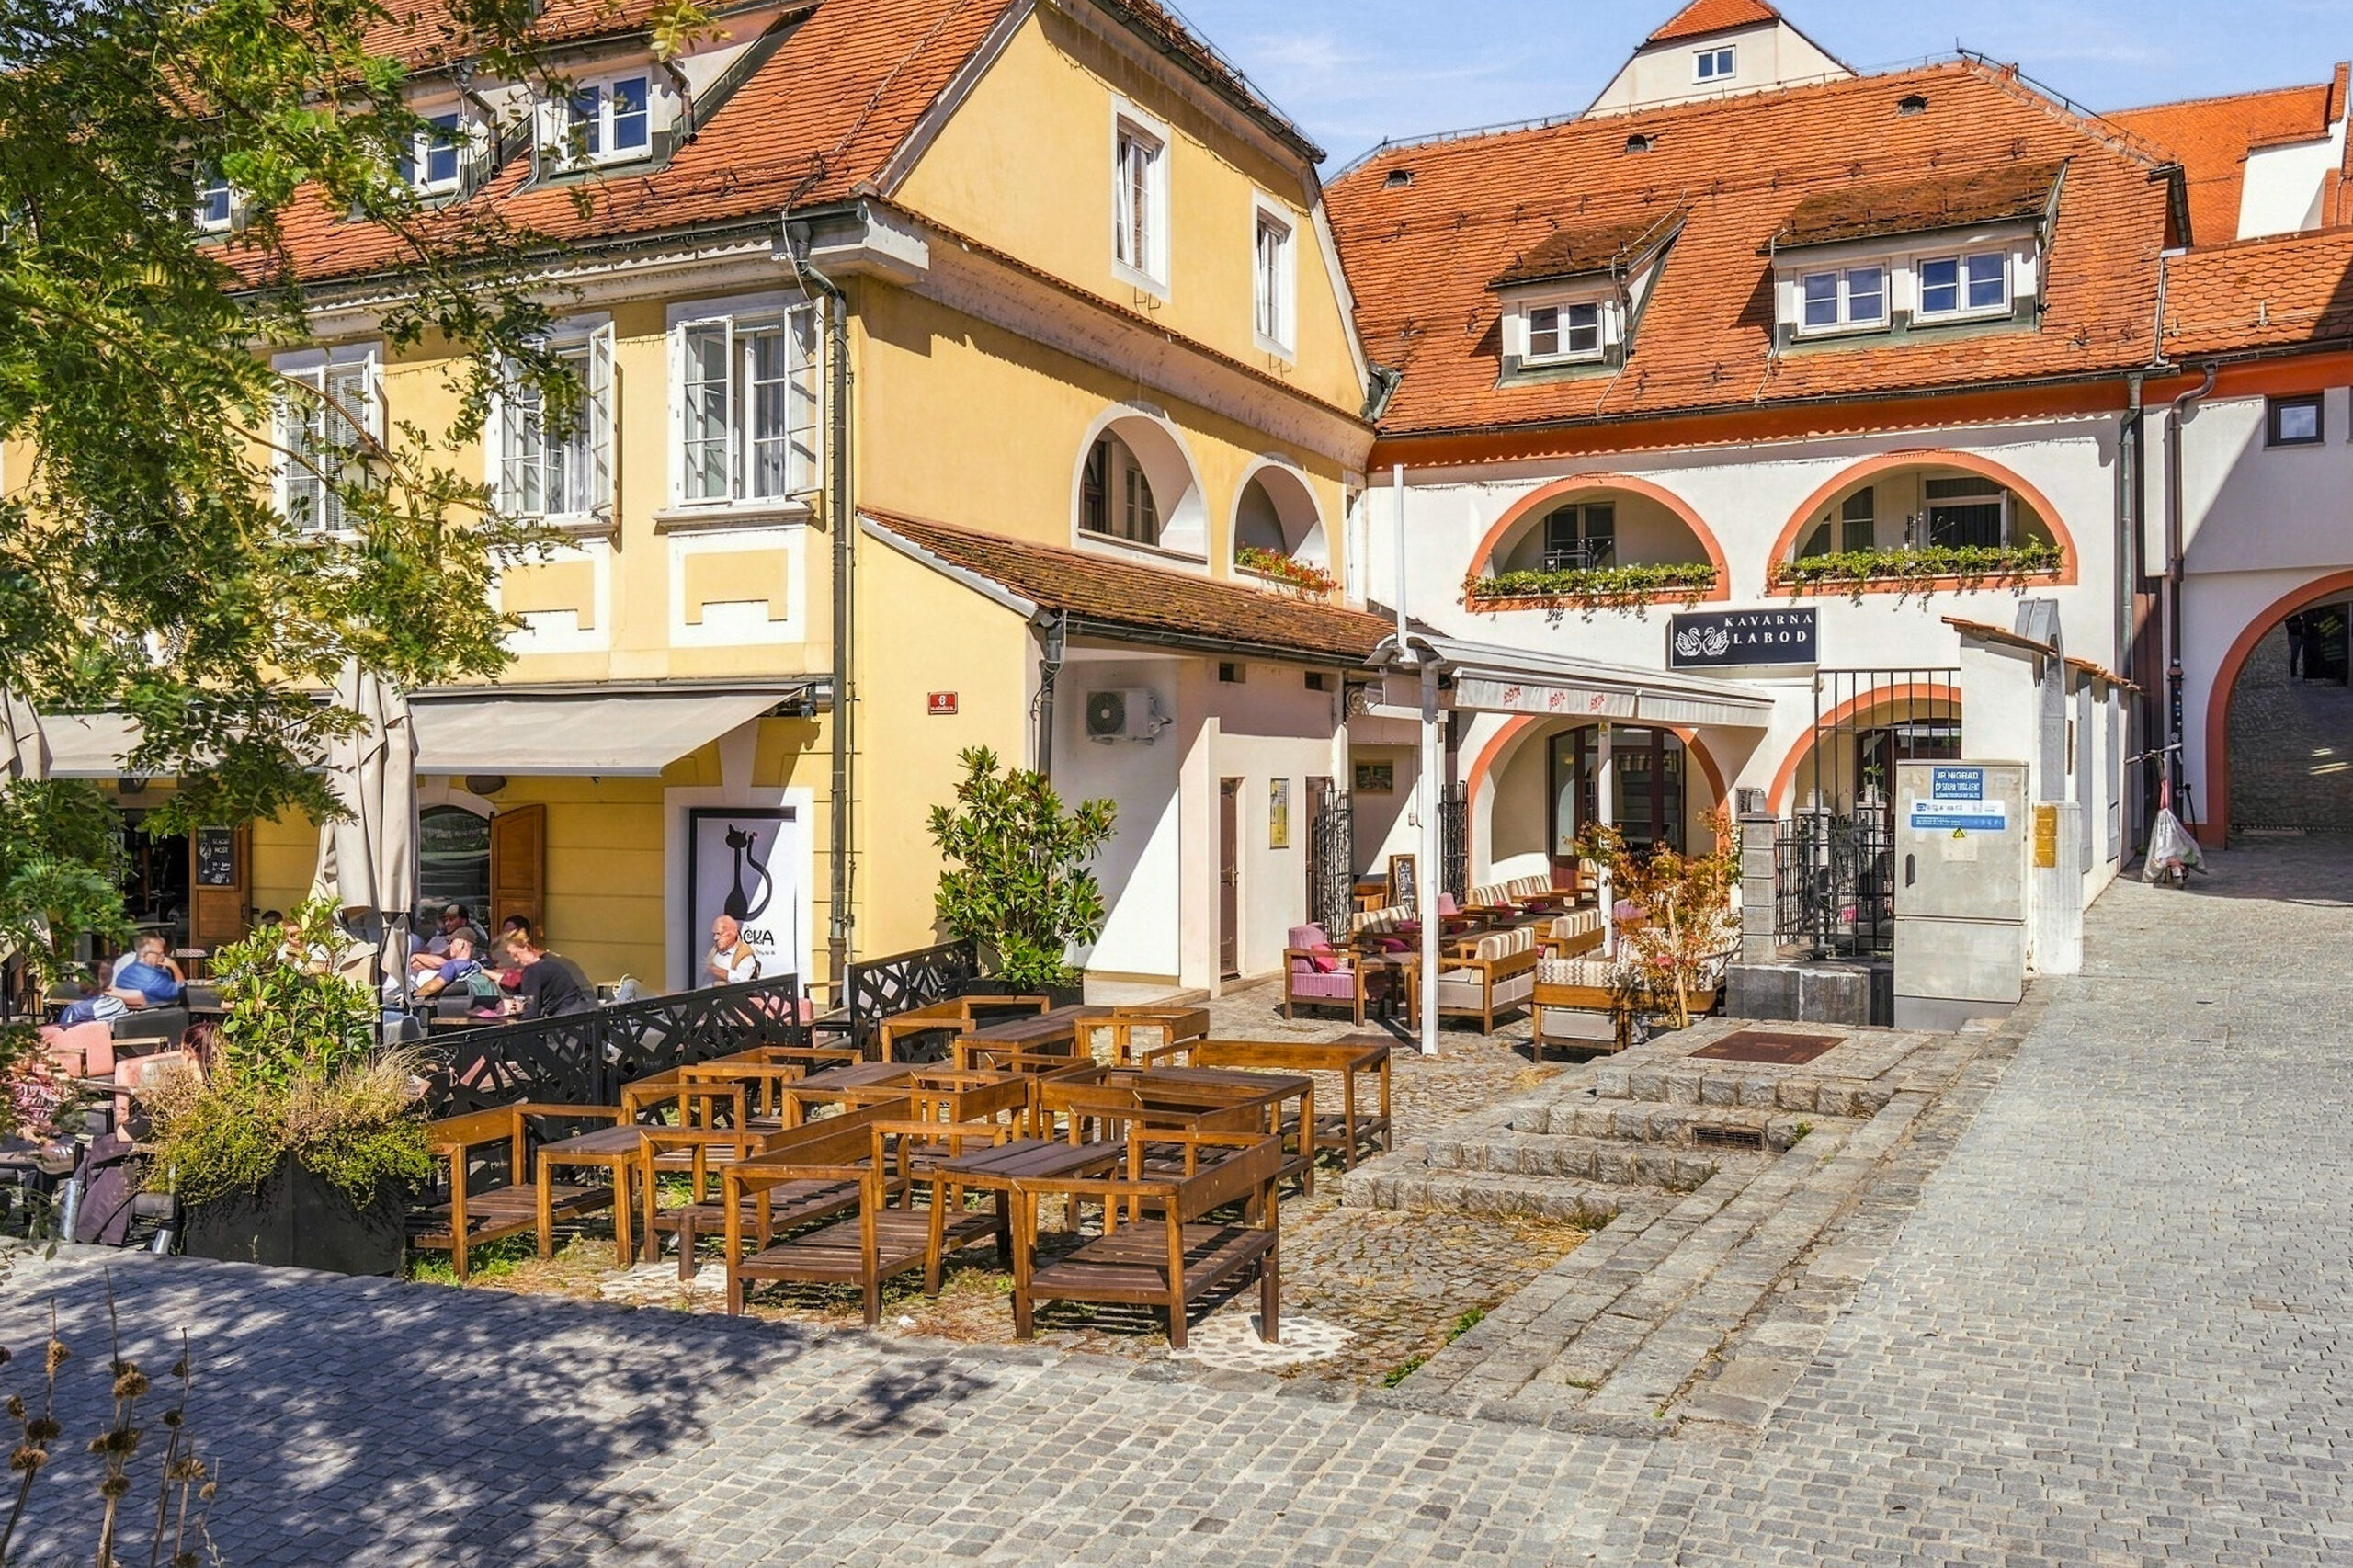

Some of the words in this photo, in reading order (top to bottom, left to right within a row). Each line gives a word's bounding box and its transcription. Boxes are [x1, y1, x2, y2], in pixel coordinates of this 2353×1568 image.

[1724, 614, 1813, 627] KAVARNA
[1733, 631, 1807, 644] LABOD
[1937, 771, 1947, 779] JP
[1947, 771, 1979, 779] NIGRAD
